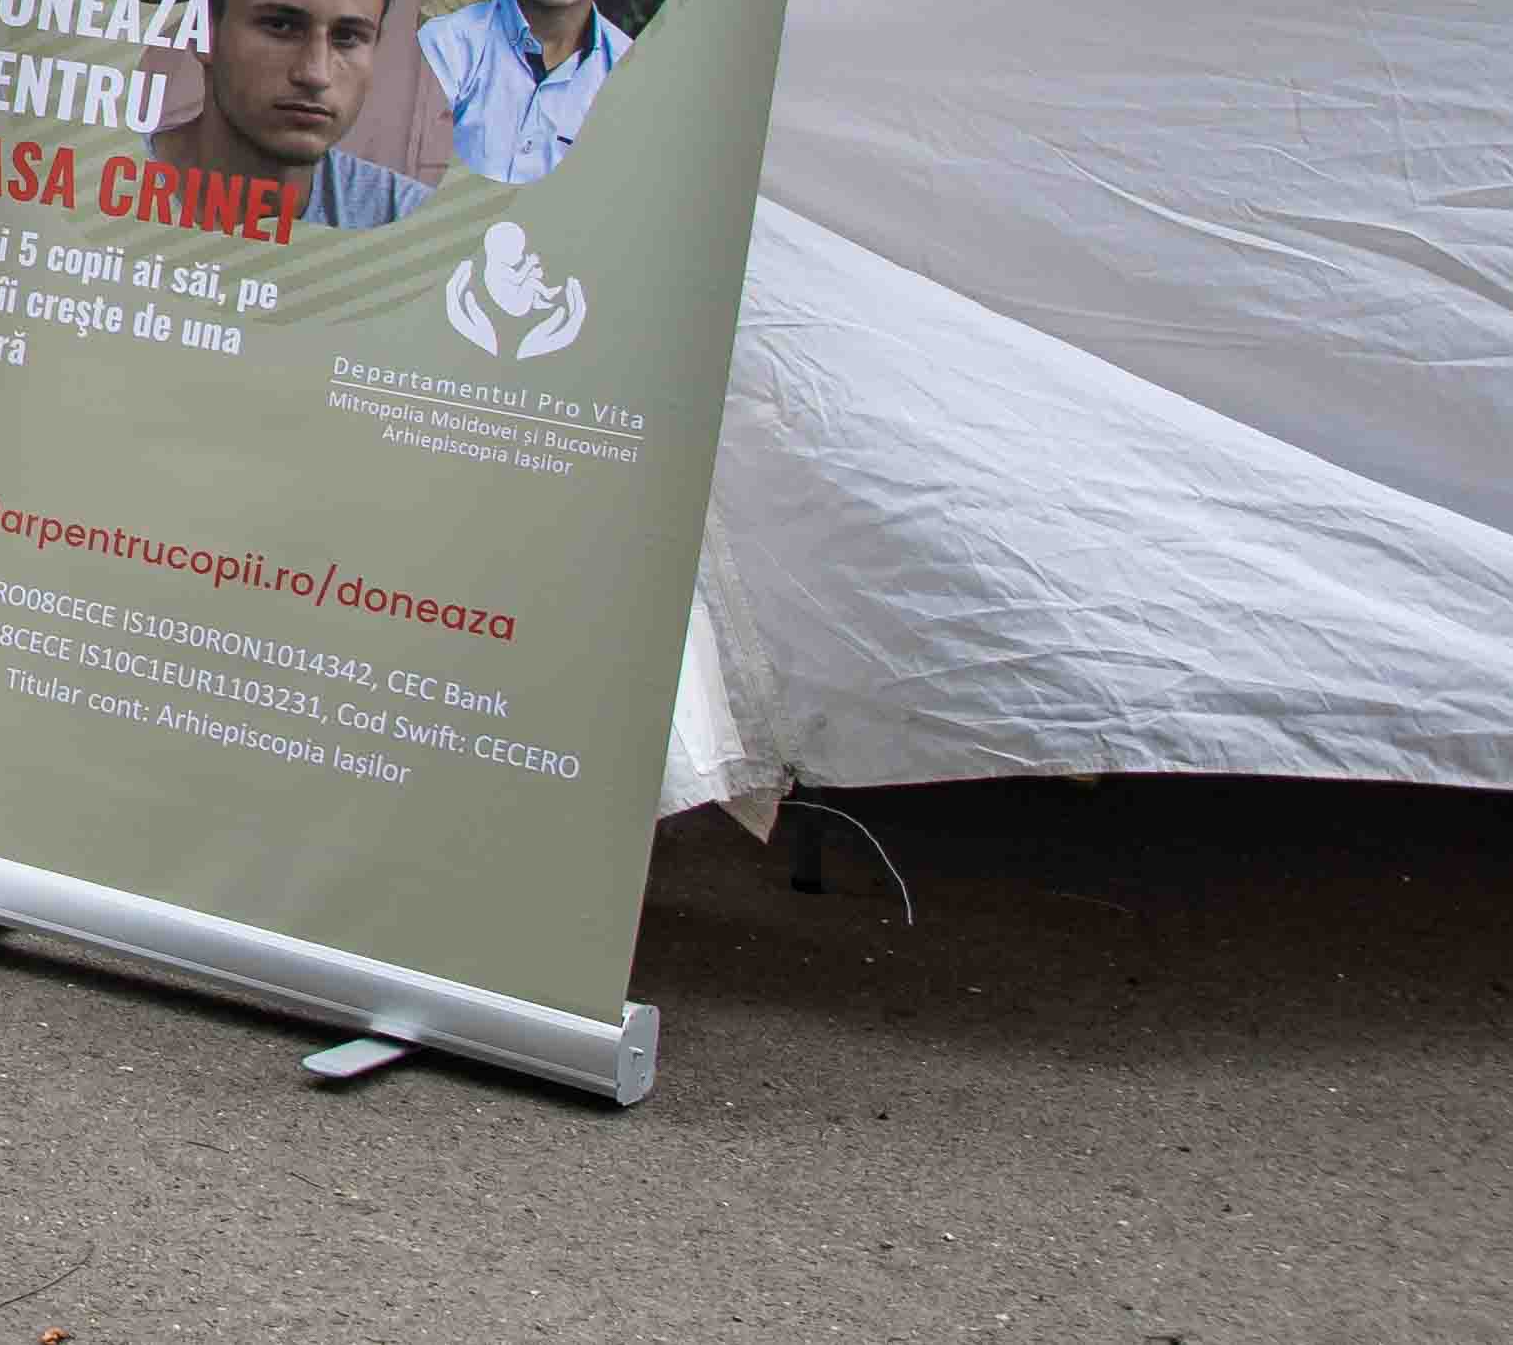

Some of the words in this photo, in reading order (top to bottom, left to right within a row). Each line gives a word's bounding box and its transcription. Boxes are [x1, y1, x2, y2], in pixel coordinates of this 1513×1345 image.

[98, 155, 302, 245] CRINEI
[18, 230, 39, 267] 5
[47, 245, 125, 286] copii
[132, 255, 164, 289] ai
[171, 261, 227, 305] săi,
[236, 277, 279, 312] pe
[132, 302, 172, 342] de
[181, 318, 242, 356] una
[328, 391, 425, 424] Mitropolia
[430, 410, 518, 441] Moldovei
[544, 430, 638, 463] Bucovinei
[332, 356, 528, 409] Departamentul
[537, 393, 581, 418] Pro
[593, 401, 645, 431] Vita
[381, 423, 509, 463] Arhiepiscopia
[514, 448, 574, 476] Iașilor
[122, 608, 380, 692] IS1030RON1014342,
[387, 669, 438, 702] CEC
[443, 682, 509, 718] Bank
[6, 666, 84, 705] Titular
[87, 692, 151, 723] cont:
[156, 704, 326, 766] Arhiepiscopia
[332, 745, 413, 785] Iașilor
[78, 642, 329, 726] IS10C1EUR1103231,
[336, 703, 388, 735] Cod
[393, 715, 466, 753] Swift:
[473, 734, 581, 780] CECERO
